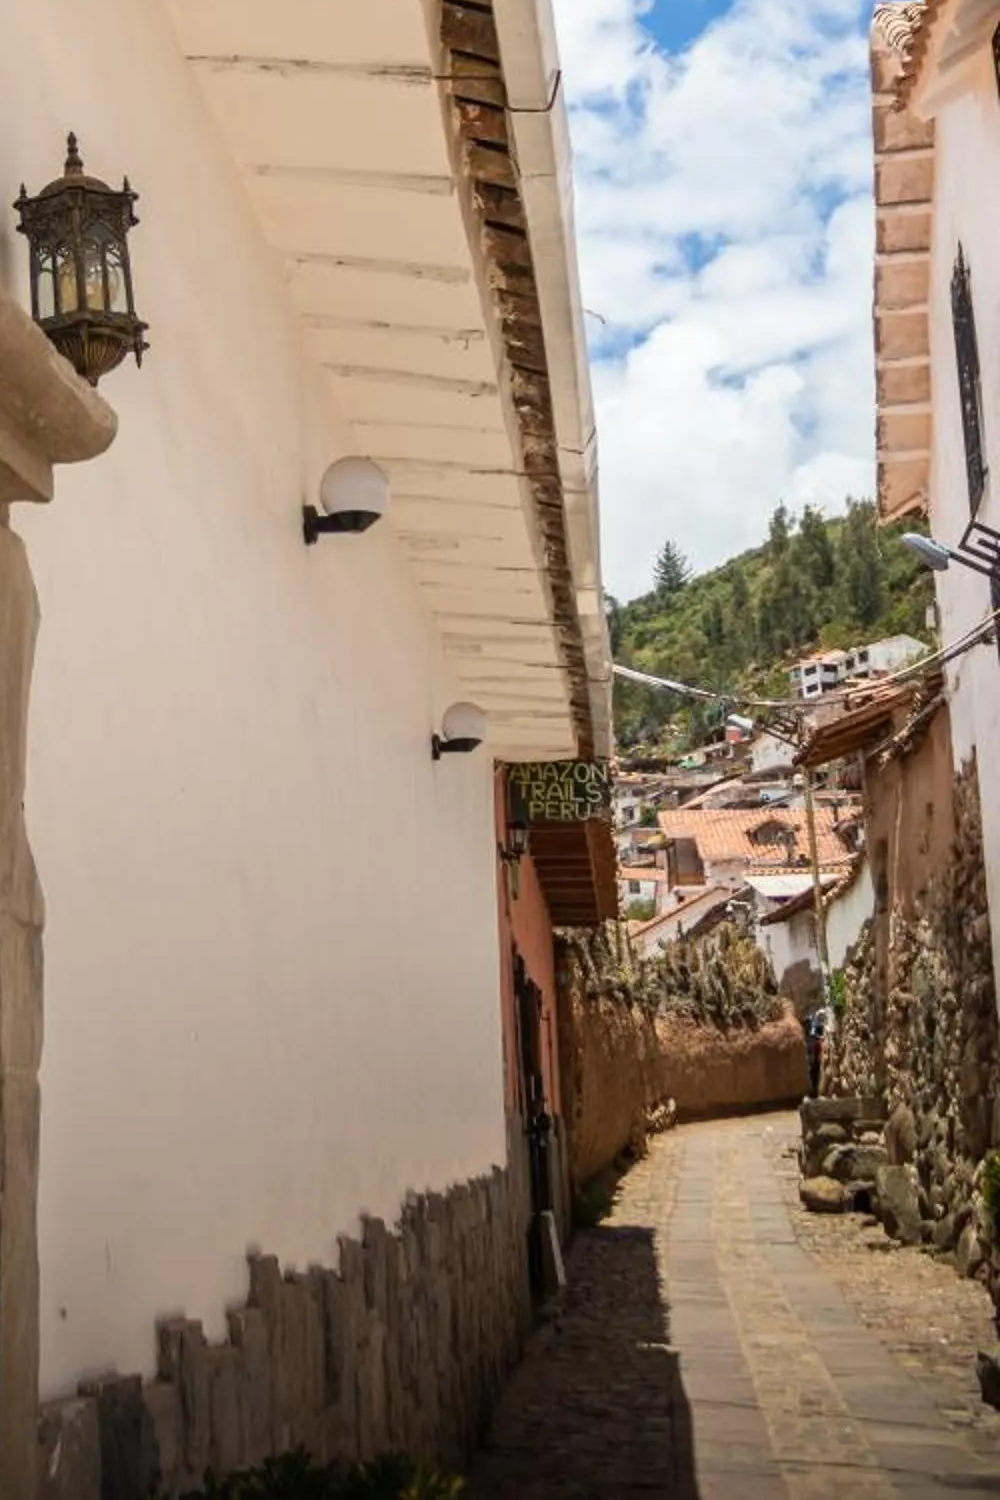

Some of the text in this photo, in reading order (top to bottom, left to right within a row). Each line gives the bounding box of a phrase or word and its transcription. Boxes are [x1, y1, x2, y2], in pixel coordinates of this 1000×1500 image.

[508, 762, 608, 783] AMAZON
[519, 780, 602, 803] TRAILS
[529, 801, 591, 821] PERU
